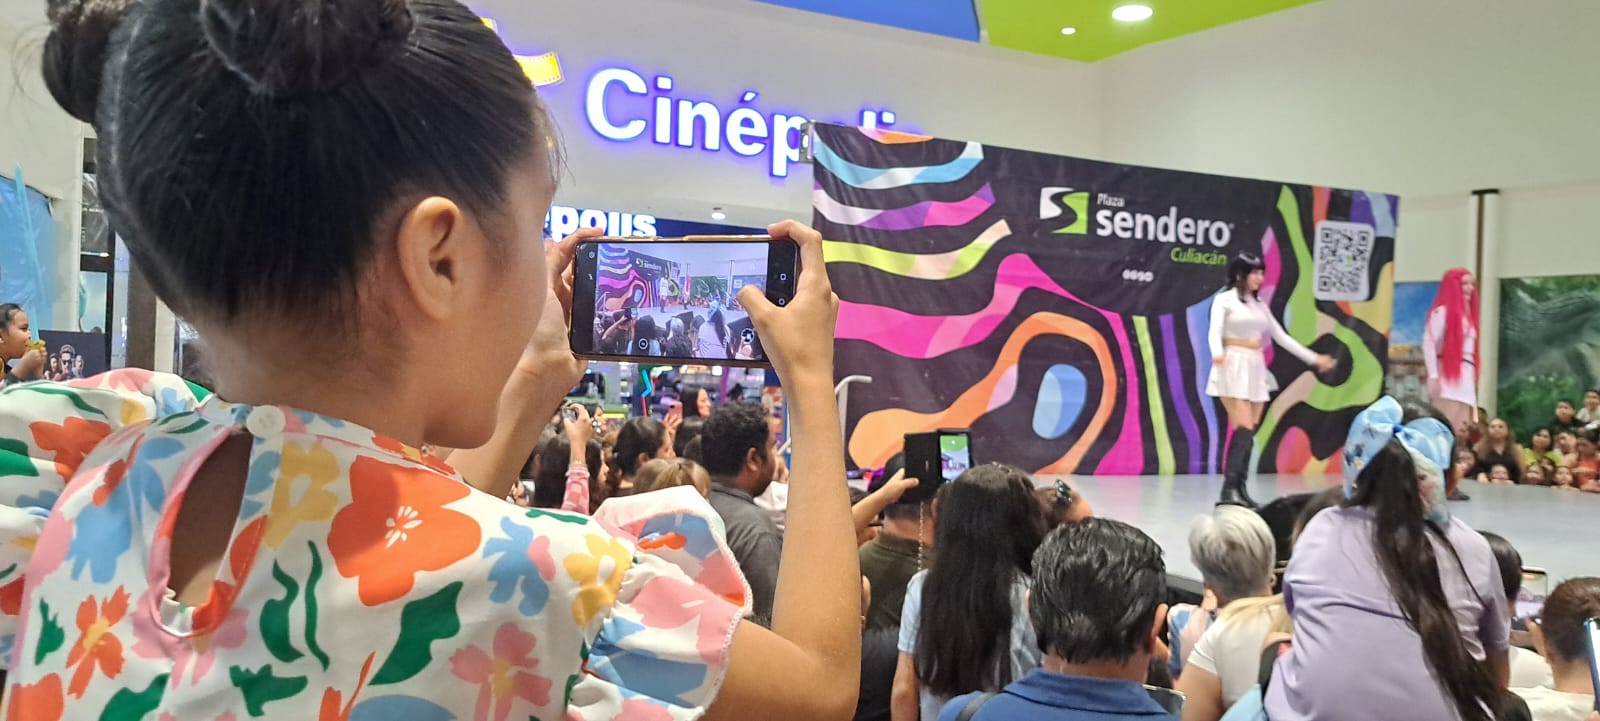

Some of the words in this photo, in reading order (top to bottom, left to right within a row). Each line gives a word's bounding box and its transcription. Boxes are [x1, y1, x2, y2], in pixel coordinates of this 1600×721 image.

[585, 67, 897, 178] Cinép
[1096, 193, 1125, 207] Plaza
[1170, 247, 1227, 265] Culiacán
